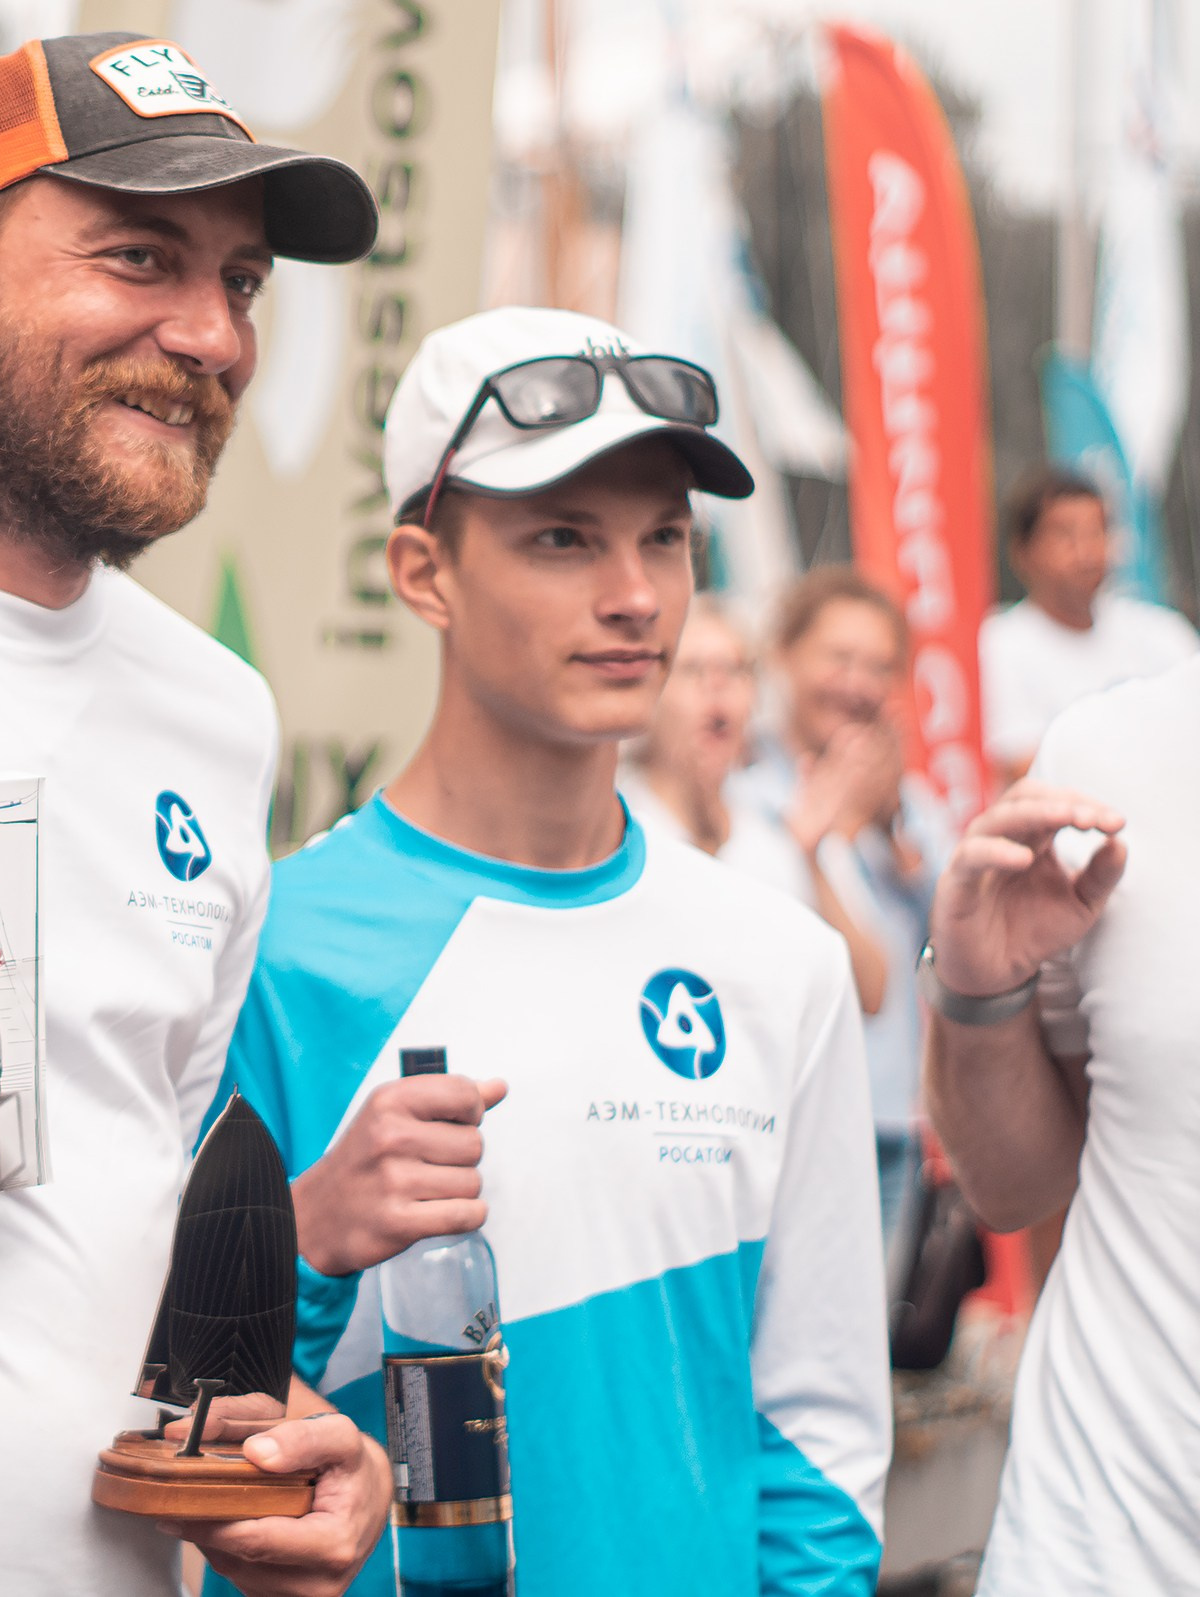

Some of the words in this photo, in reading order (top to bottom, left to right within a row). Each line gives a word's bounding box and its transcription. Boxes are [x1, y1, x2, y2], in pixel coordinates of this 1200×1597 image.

[110, 48, 174, 77] FLY
[127, 890, 233, 924] АЭМ-ТЕХНОЛОГ
[171, 931, 213, 950] РОСАТОМ
